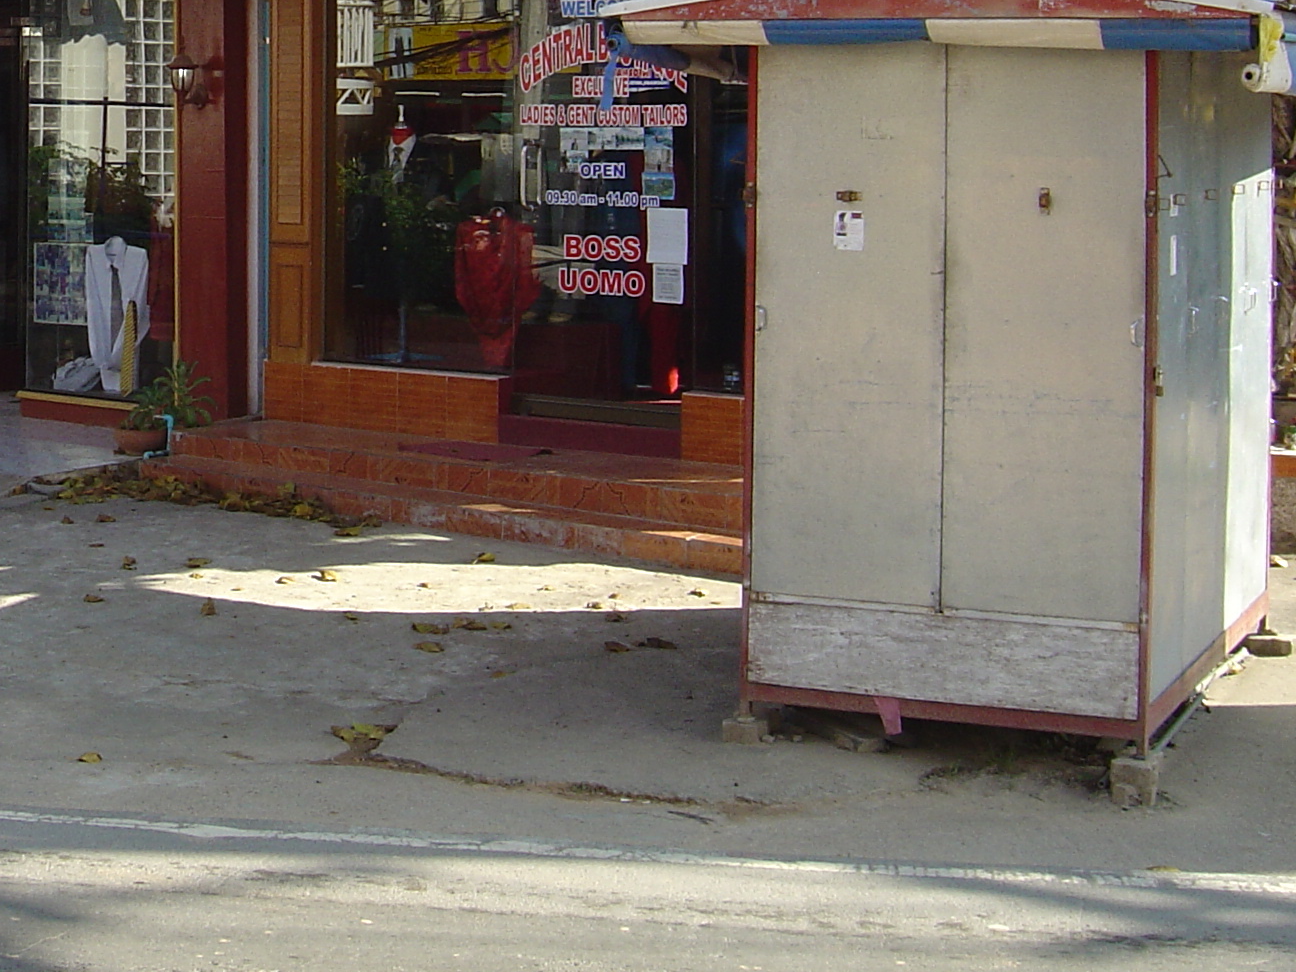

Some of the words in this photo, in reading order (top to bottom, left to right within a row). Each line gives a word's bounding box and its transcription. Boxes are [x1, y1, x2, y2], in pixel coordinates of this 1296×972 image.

[520, 23, 595, 92] CENTRAL
[520, 104, 555, 126] LADIES
[557, 104, 565, 125] &
[567, 104, 596, 126] GENT
[596, 104, 640, 126] CUSTOM
[642, 104, 687, 126] TAILORS
[580, 162, 625, 178] OPEN
[546, 190, 577, 205] 09.30
[579, 194, 597, 206] am
[606, 191, 639, 207] 11.00
[640, 195, 659, 210] pm
[564, 234, 641, 262] BOSS
[559, 268, 645, 297] UOMO
